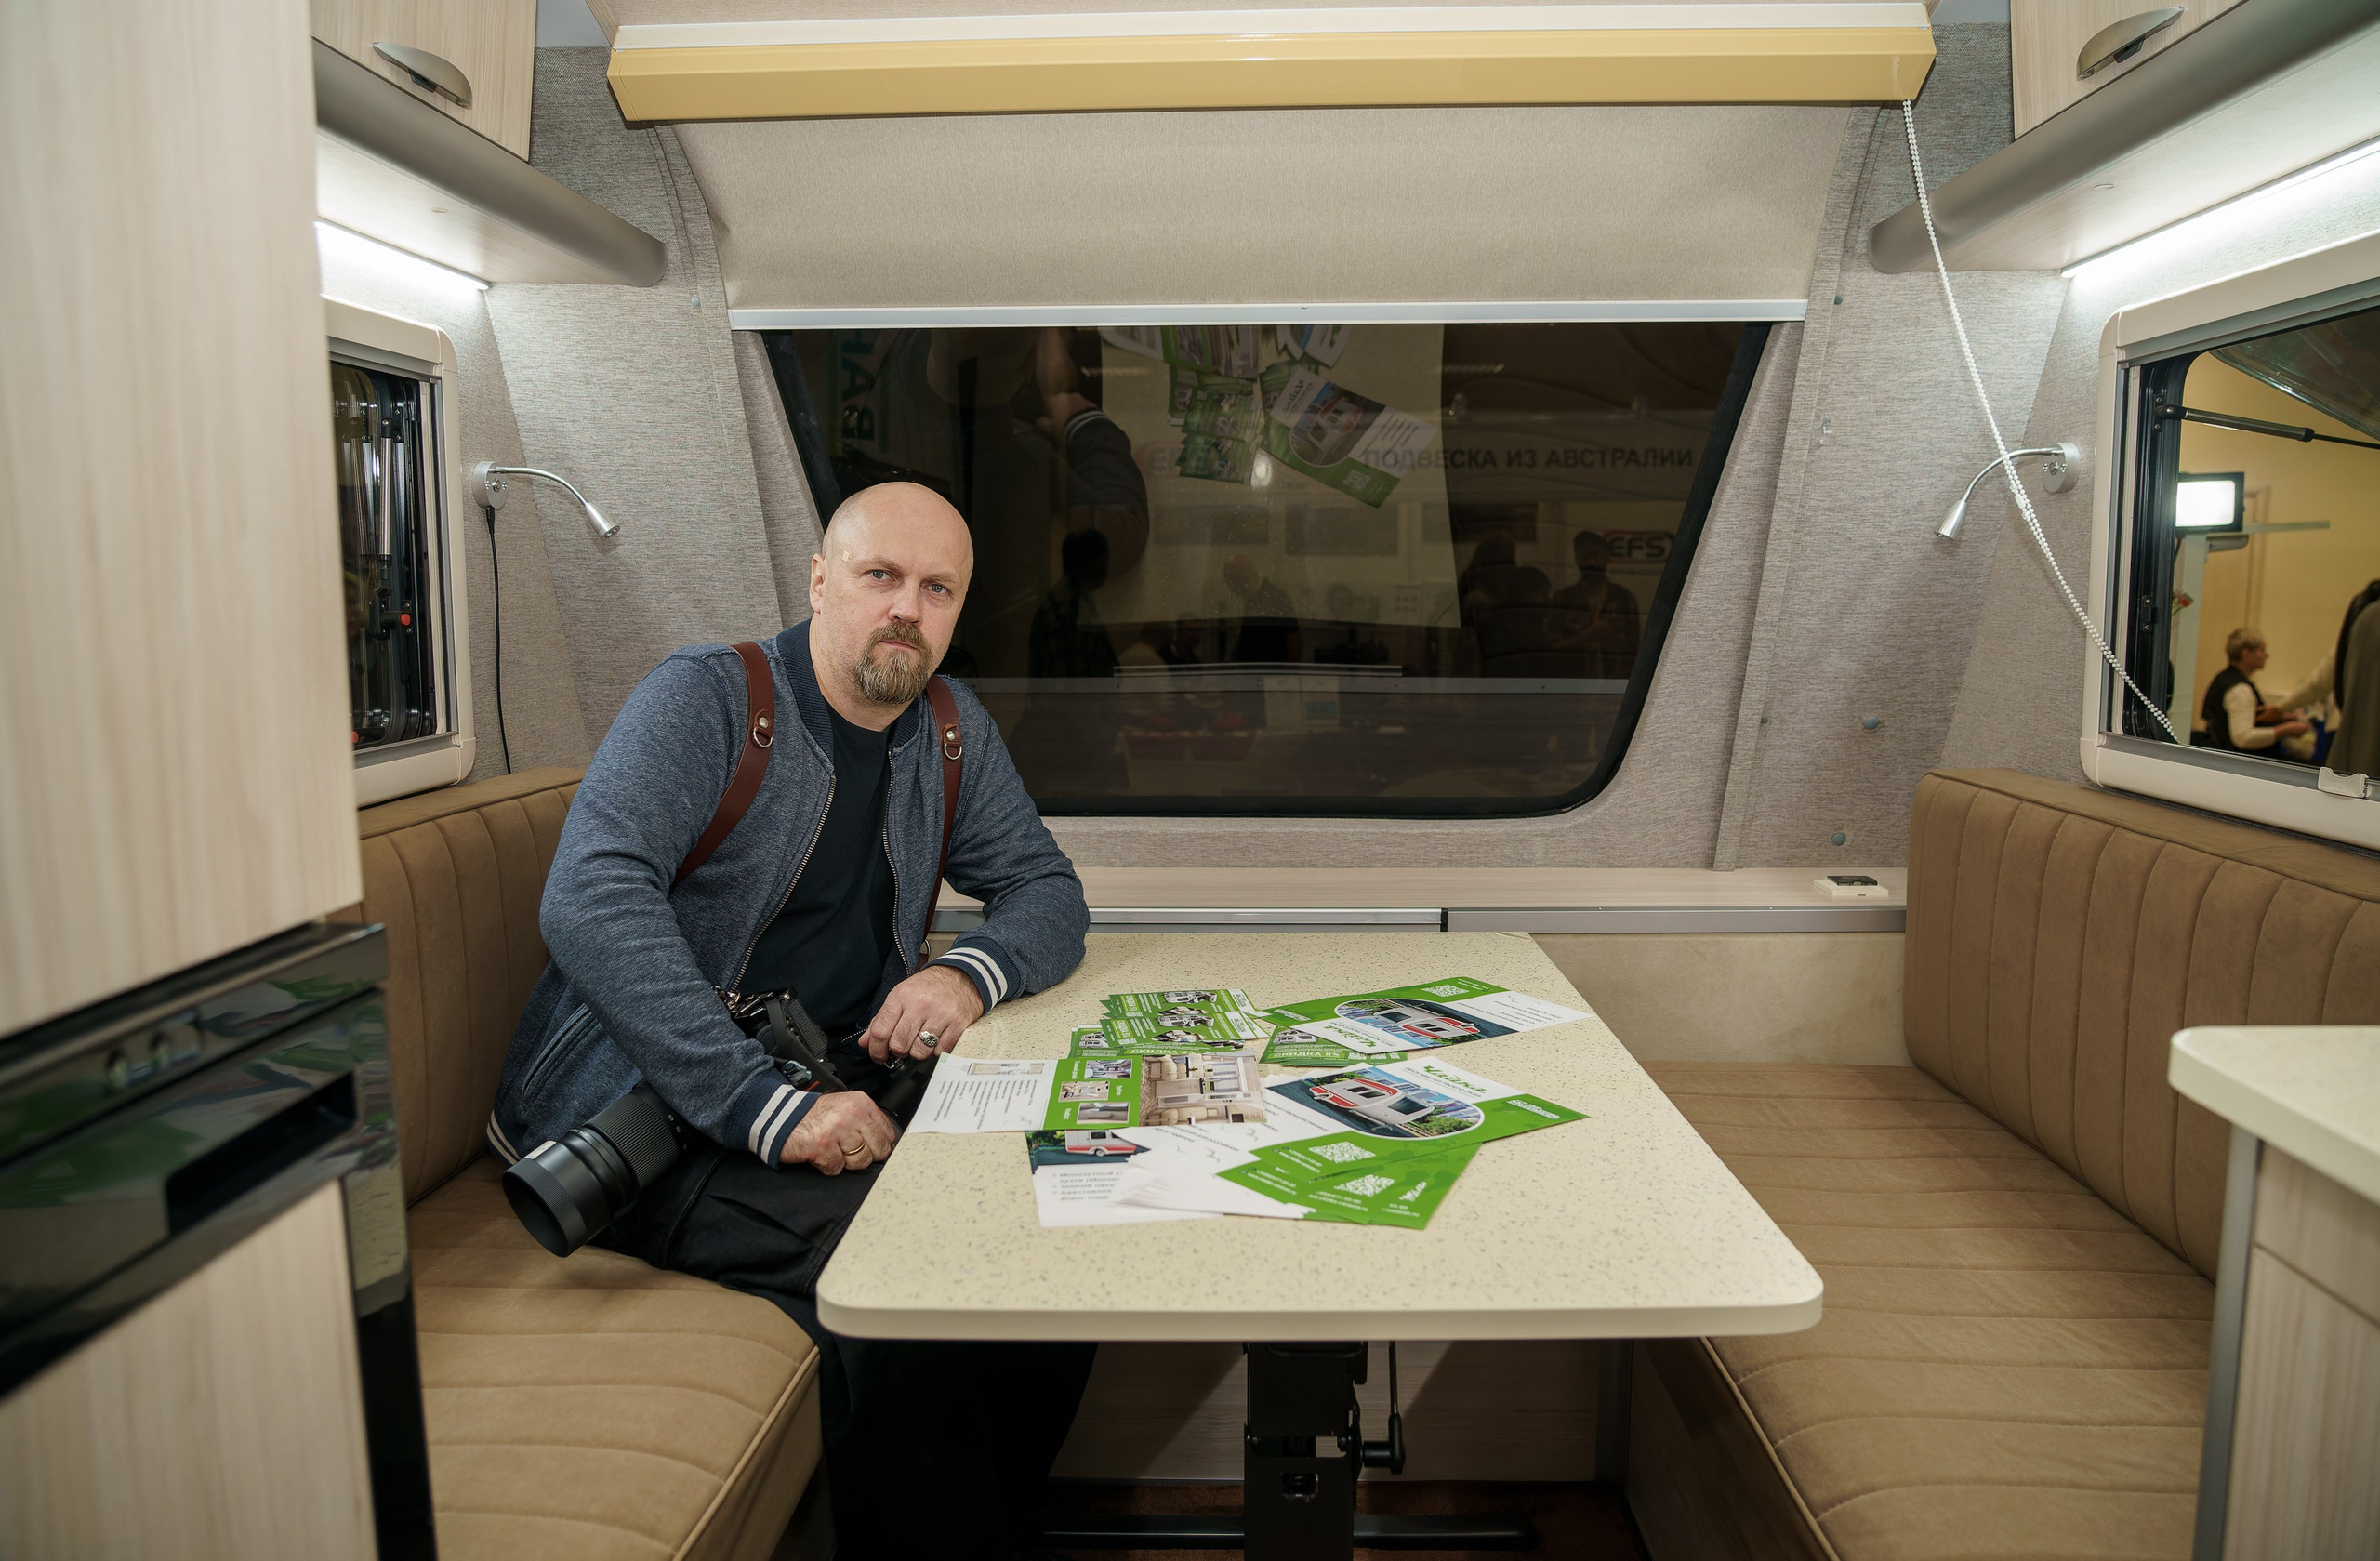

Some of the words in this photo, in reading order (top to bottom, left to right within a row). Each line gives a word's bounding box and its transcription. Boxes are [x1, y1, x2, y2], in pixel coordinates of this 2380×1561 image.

[1364, 448, 1498, 470] ПОДВЕСКА
[1506, 449, 1537, 469] ИЗ
[1544, 448, 1693, 469] АВСТРАЛИИ
[1609, 536, 1666, 558] EFS
